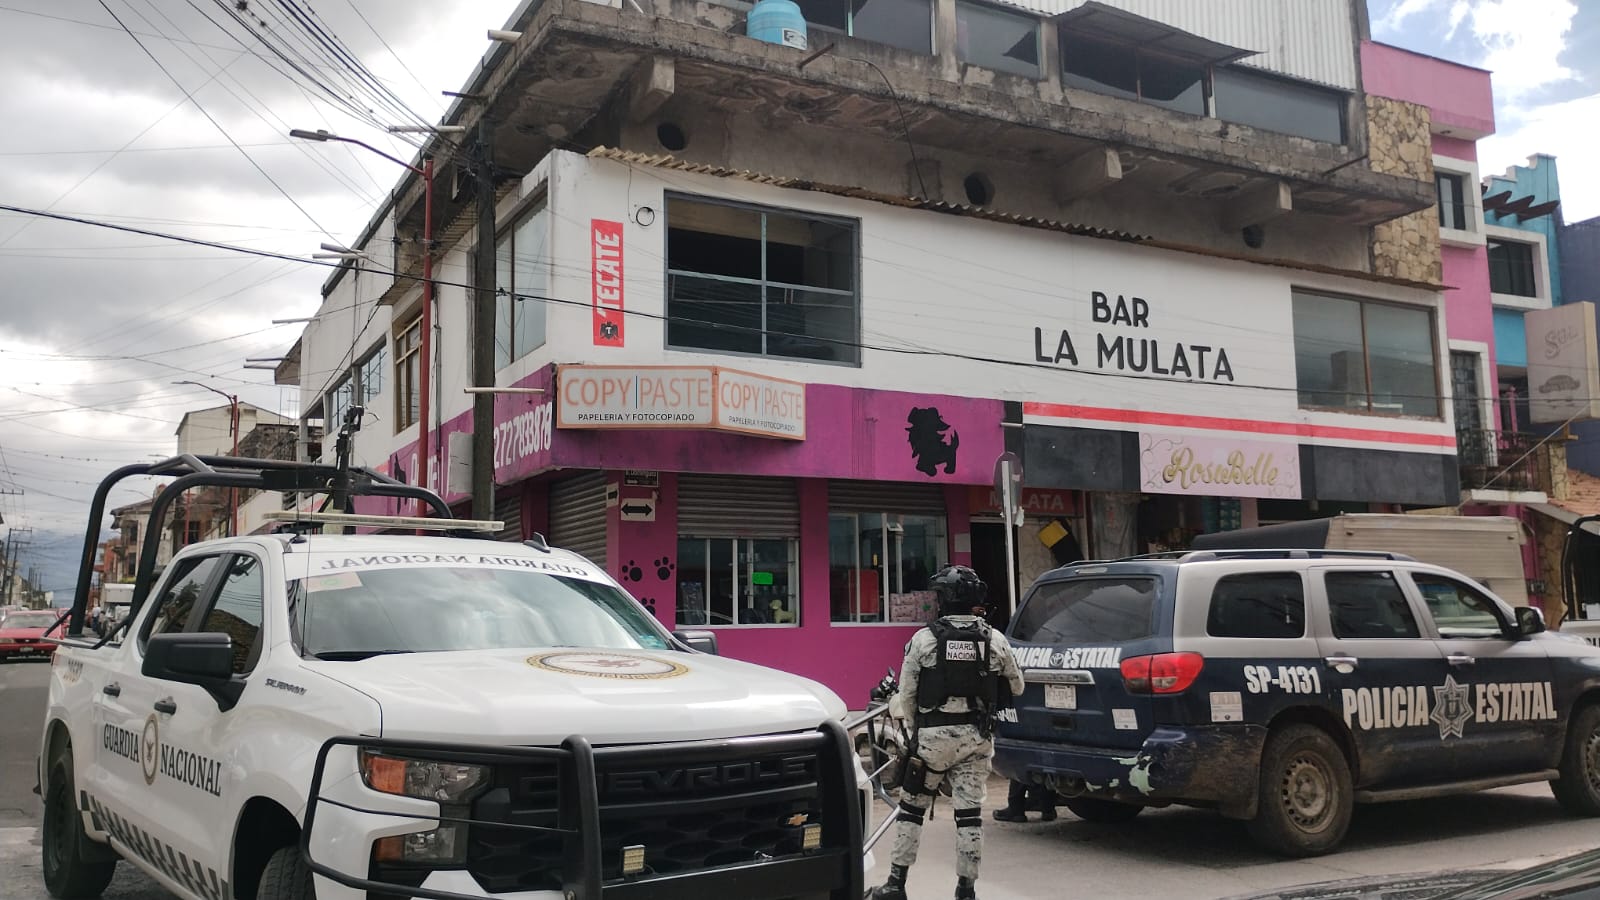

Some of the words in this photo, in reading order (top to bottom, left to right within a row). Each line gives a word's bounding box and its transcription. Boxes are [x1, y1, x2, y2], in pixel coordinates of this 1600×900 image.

[595, 229, 620, 318] TECATE
[1091, 291, 1149, 328] BAR
[1034, 326, 1078, 366] LA
[1097, 332, 1234, 382] MULATA
[565, 378, 632, 408] COPY
[640, 377, 710, 408] PASTE
[721, 380, 760, 410] COPY
[764, 385, 802, 421] PASTE
[578, 413, 624, 422] PAPELERIA
[625, 414, 630, 422] Y
[632, 413, 695, 422] FOTOCOPIADO
[728, 415, 756, 426] PAPELERIA
[989, 490, 1064, 511] MATA
[947, 651, 977, 660] NACION
[948, 642, 976, 651] GUARD
[1062, 647, 1122, 669] ESTATAL
[1244, 665, 1321, 694] SP-4131
[1341, 686, 1429, 730] POLICIA
[1475, 682, 1557, 723] ESTATAL
[103, 723, 139, 763] GUARDIA
[160, 743, 221, 797] NACIONAL
[519, 754, 817, 795] CEVROLE
